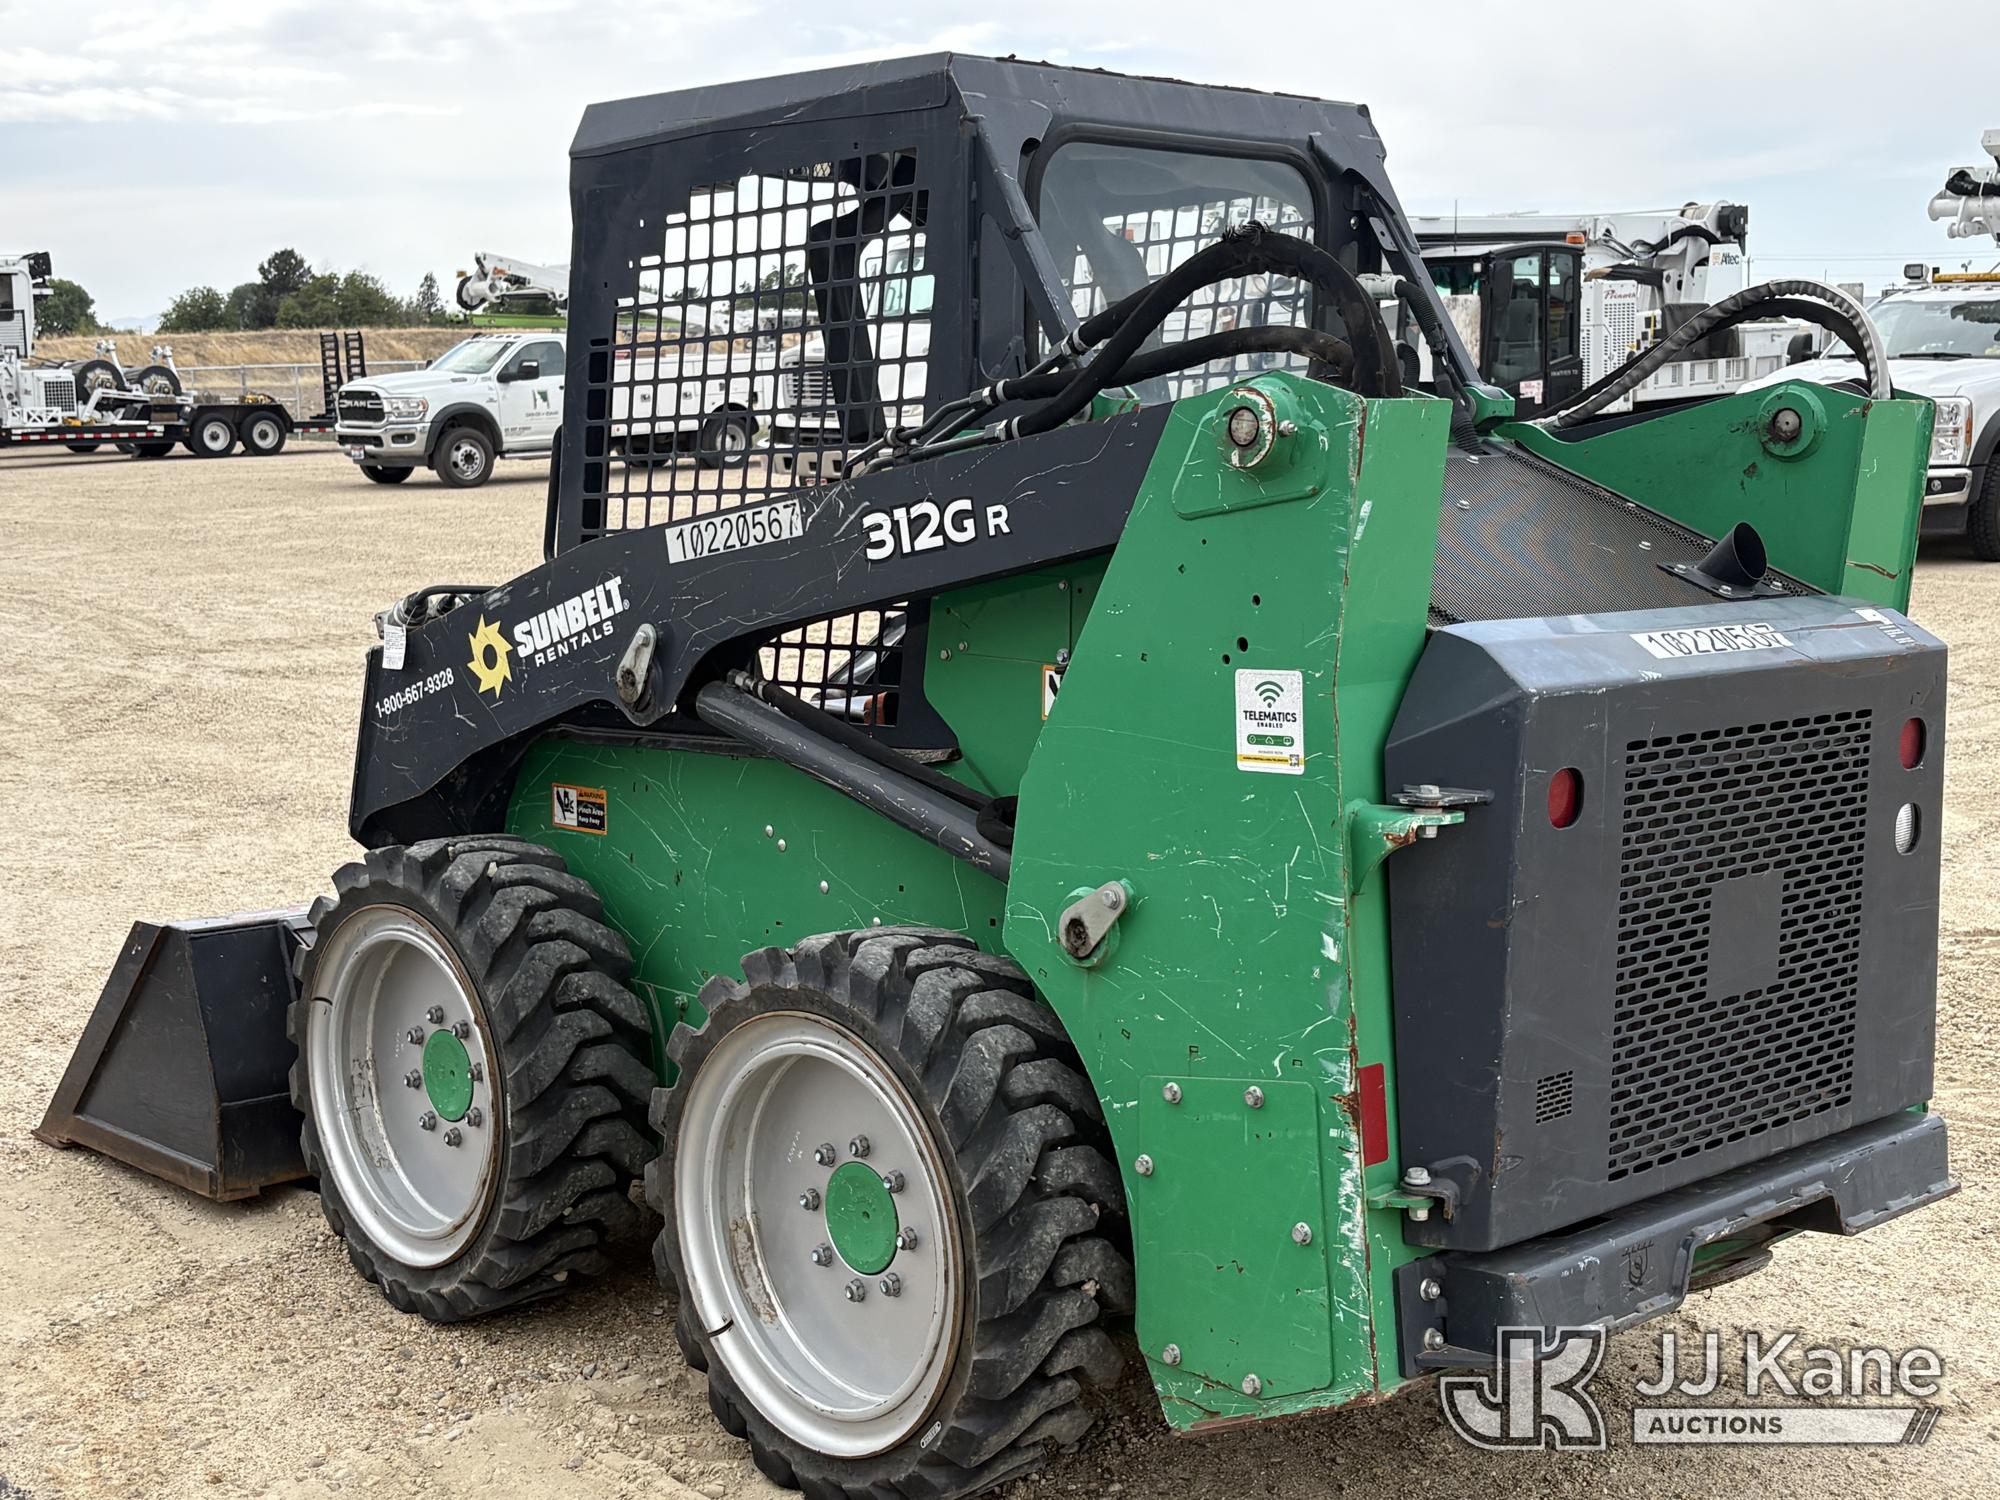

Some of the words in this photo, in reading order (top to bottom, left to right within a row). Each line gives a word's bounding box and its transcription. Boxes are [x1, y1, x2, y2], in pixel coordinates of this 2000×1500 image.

[1720, 252, 1740, 265] Altec
[676, 502, 797, 560] 10220567
[862, 499, 976, 561] 312G
[986, 504, 1011, 537] R
[534, 620, 614, 668] RENTALS
[375, 667, 455, 719] 1-800-667-9328
[1243, 710, 1297, 723] TELEMATICS
